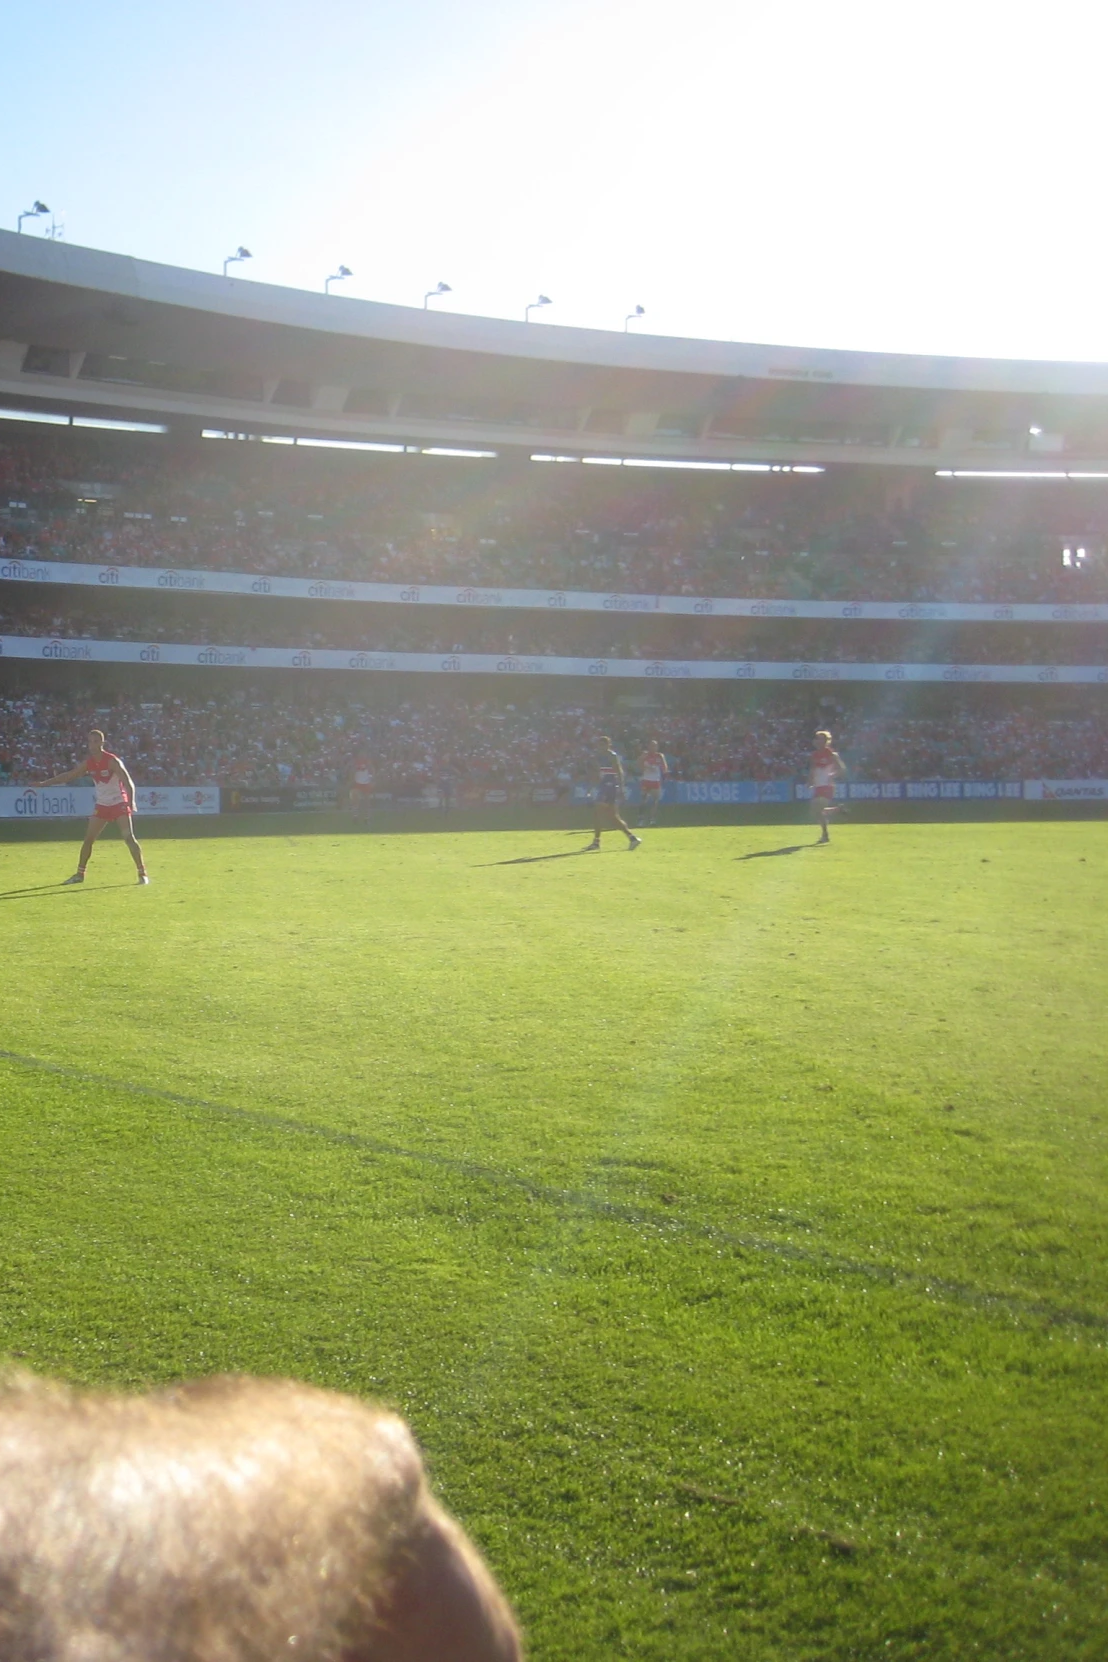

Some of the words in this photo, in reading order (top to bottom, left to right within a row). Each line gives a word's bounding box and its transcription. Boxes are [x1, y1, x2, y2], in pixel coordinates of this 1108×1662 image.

[0, 560, 50, 581] citibank
[98, 567, 119, 585] citi
[157, 570, 205, 588] citibank
[251, 576, 271, 594] citi
[308, 581, 355, 598] citibank
[400, 586, 420, 602] citi
[456, 587, 502, 604] citibank
[547, 592, 567, 607] citi
[694, 599, 713, 613] citi
[842, 602, 862, 617] citi
[42, 640, 91, 659] citibank
[140, 644, 160, 661] citi
[197, 646, 246, 664] citibank
[292, 651, 312, 667] citi
[349, 652, 396, 669] citibank
[441, 655, 461, 671] citi
[497, 657, 544, 672] citibank
[587, 659, 608, 675] citi
[736, 662, 755, 678] citi
[709, 783, 740, 801] QBE
[881, 783, 901, 798] LEE
[940, 783, 961, 798] LEE
[1054, 787, 1104, 798] QANTAS
[15, 788, 76, 815] citibank
